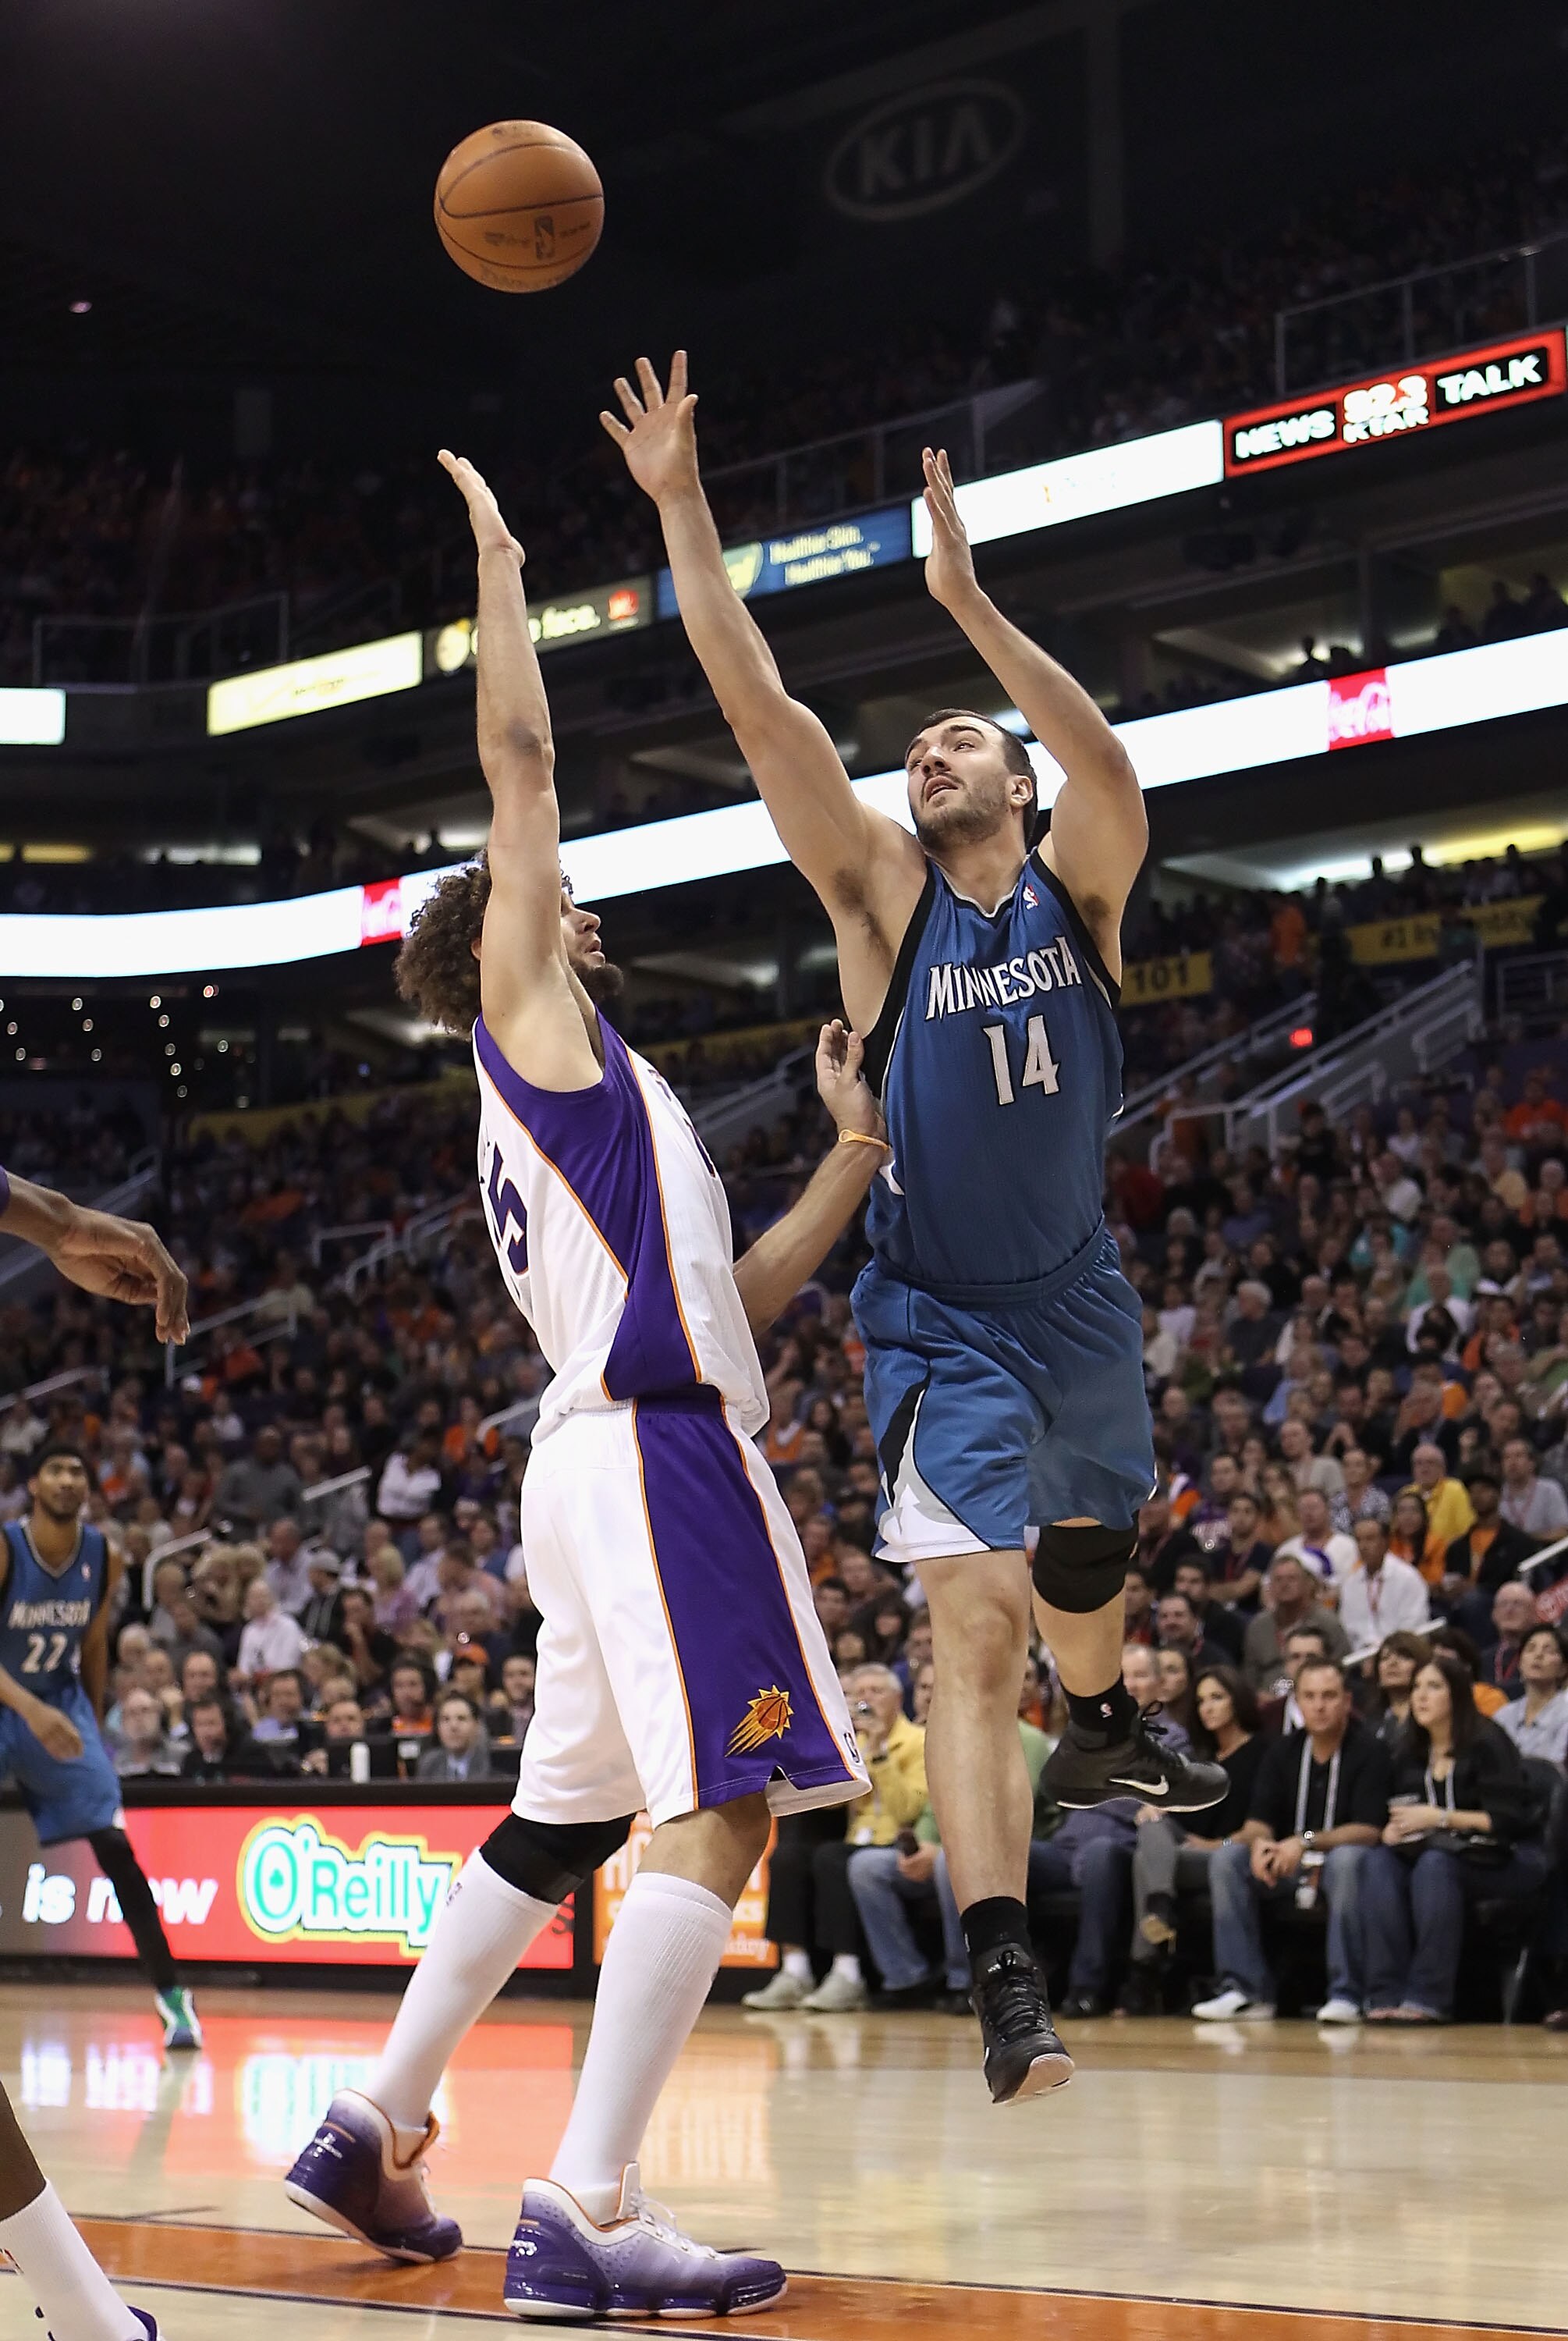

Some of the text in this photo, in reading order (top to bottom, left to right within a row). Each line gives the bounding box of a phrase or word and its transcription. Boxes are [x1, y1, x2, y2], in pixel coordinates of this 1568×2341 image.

[858, 102, 991, 197] KIA
[1234, 409, 1336, 459] NEWS
[1436, 354, 1543, 404] TALK
[1342, 405, 1430, 444] KTAR
[924, 936, 1082, 1022] MINNESOTA
[1135, 961, 1188, 993] 101
[982, 1014, 1060, 1106] 14
[22, 1863, 218, 1924] is nw
[248, 1830, 448, 1941] O'Reilly
